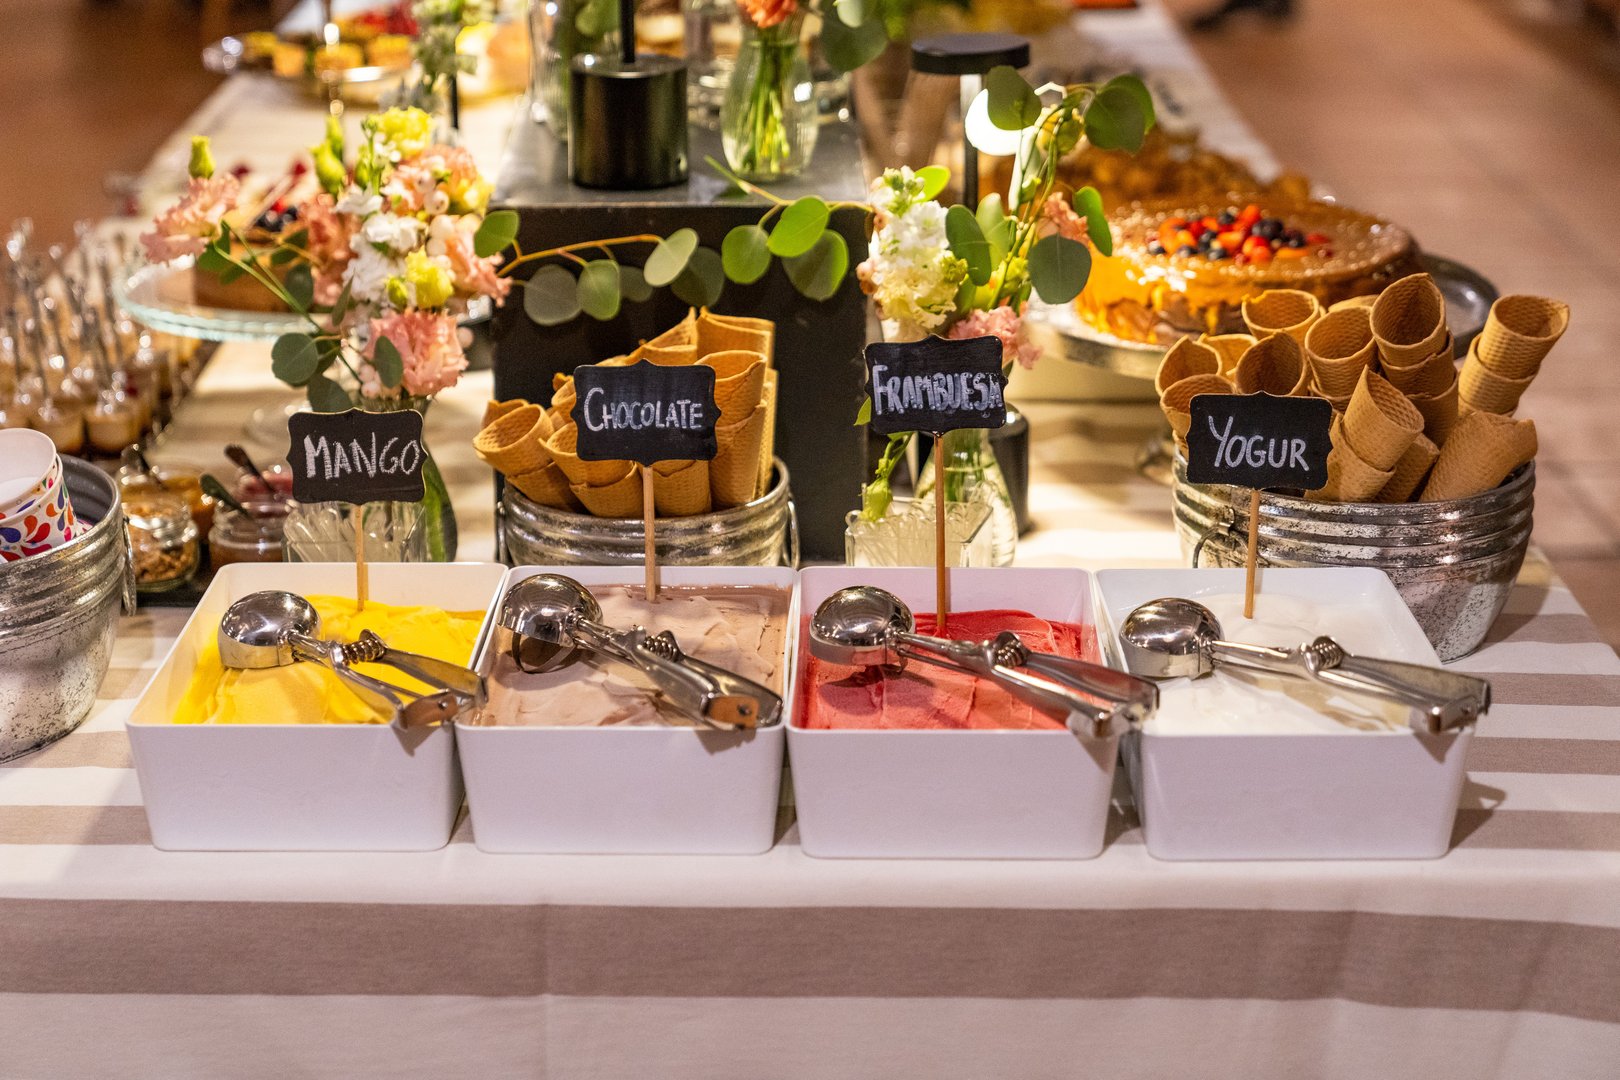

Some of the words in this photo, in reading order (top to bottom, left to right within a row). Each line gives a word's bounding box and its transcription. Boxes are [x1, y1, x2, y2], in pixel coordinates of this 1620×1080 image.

[583, 387, 704, 432] CHOCOLATE
[872, 364, 1003, 416] FRAMBUESA
[303, 432, 420, 480] MANGO
[1207, 415, 1310, 472] YOGUR
